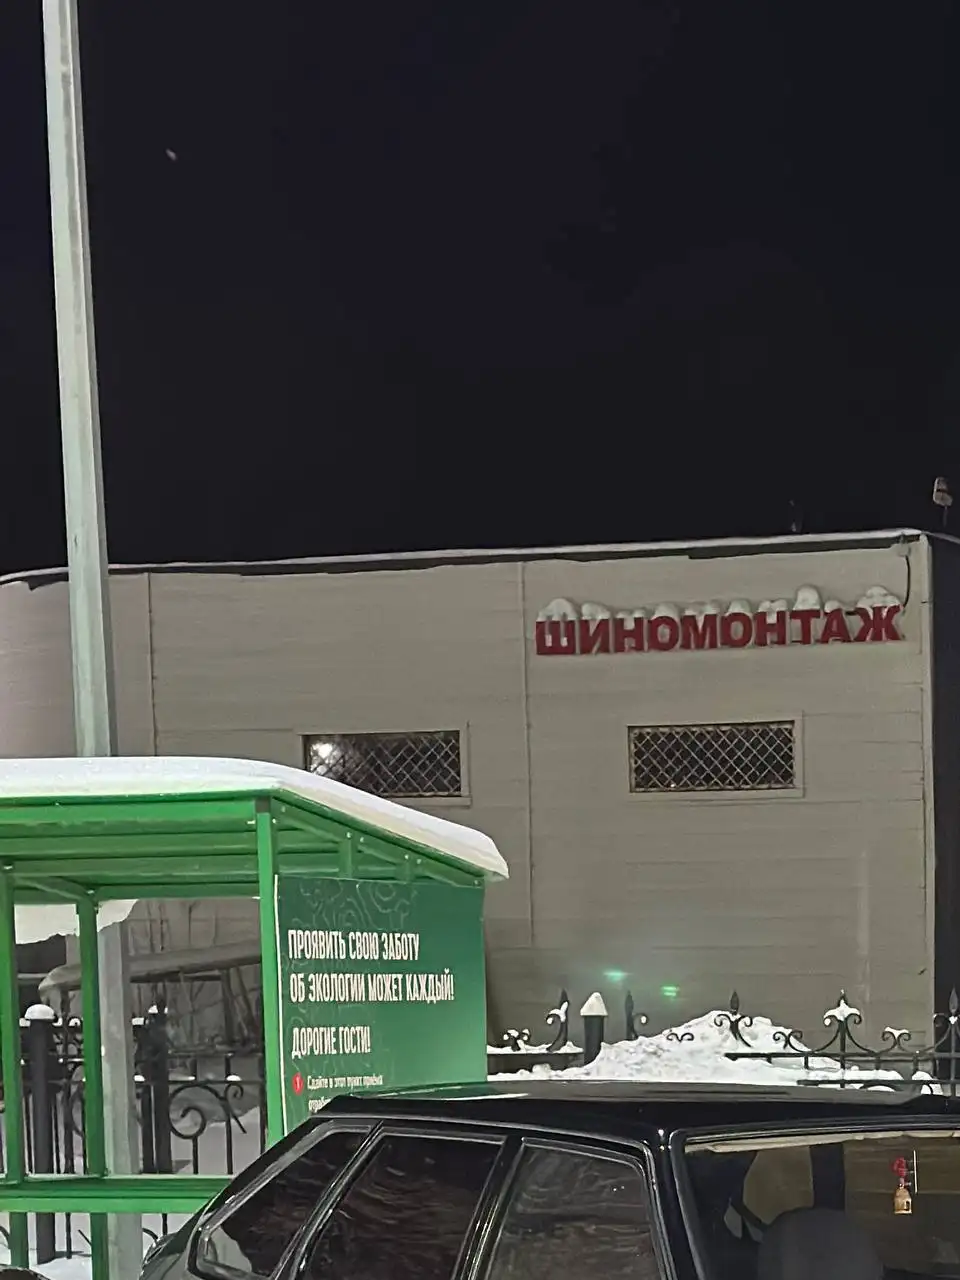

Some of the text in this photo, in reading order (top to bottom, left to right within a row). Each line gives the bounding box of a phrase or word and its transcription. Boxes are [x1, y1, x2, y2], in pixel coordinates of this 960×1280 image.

[535, 603, 904, 655] ШИНОМОНТАЖ
[287, 930, 420, 961] ПРОЯВИТЬ СВОЮ ЗАБОТУ
[290, 968, 455, 1004] ОБ ЭКОЛОГИИ МОЖЕТ КАЖДЫЙ!
[291, 1026, 371, 1059] ДОРОГИЕ ГОСТИ!
